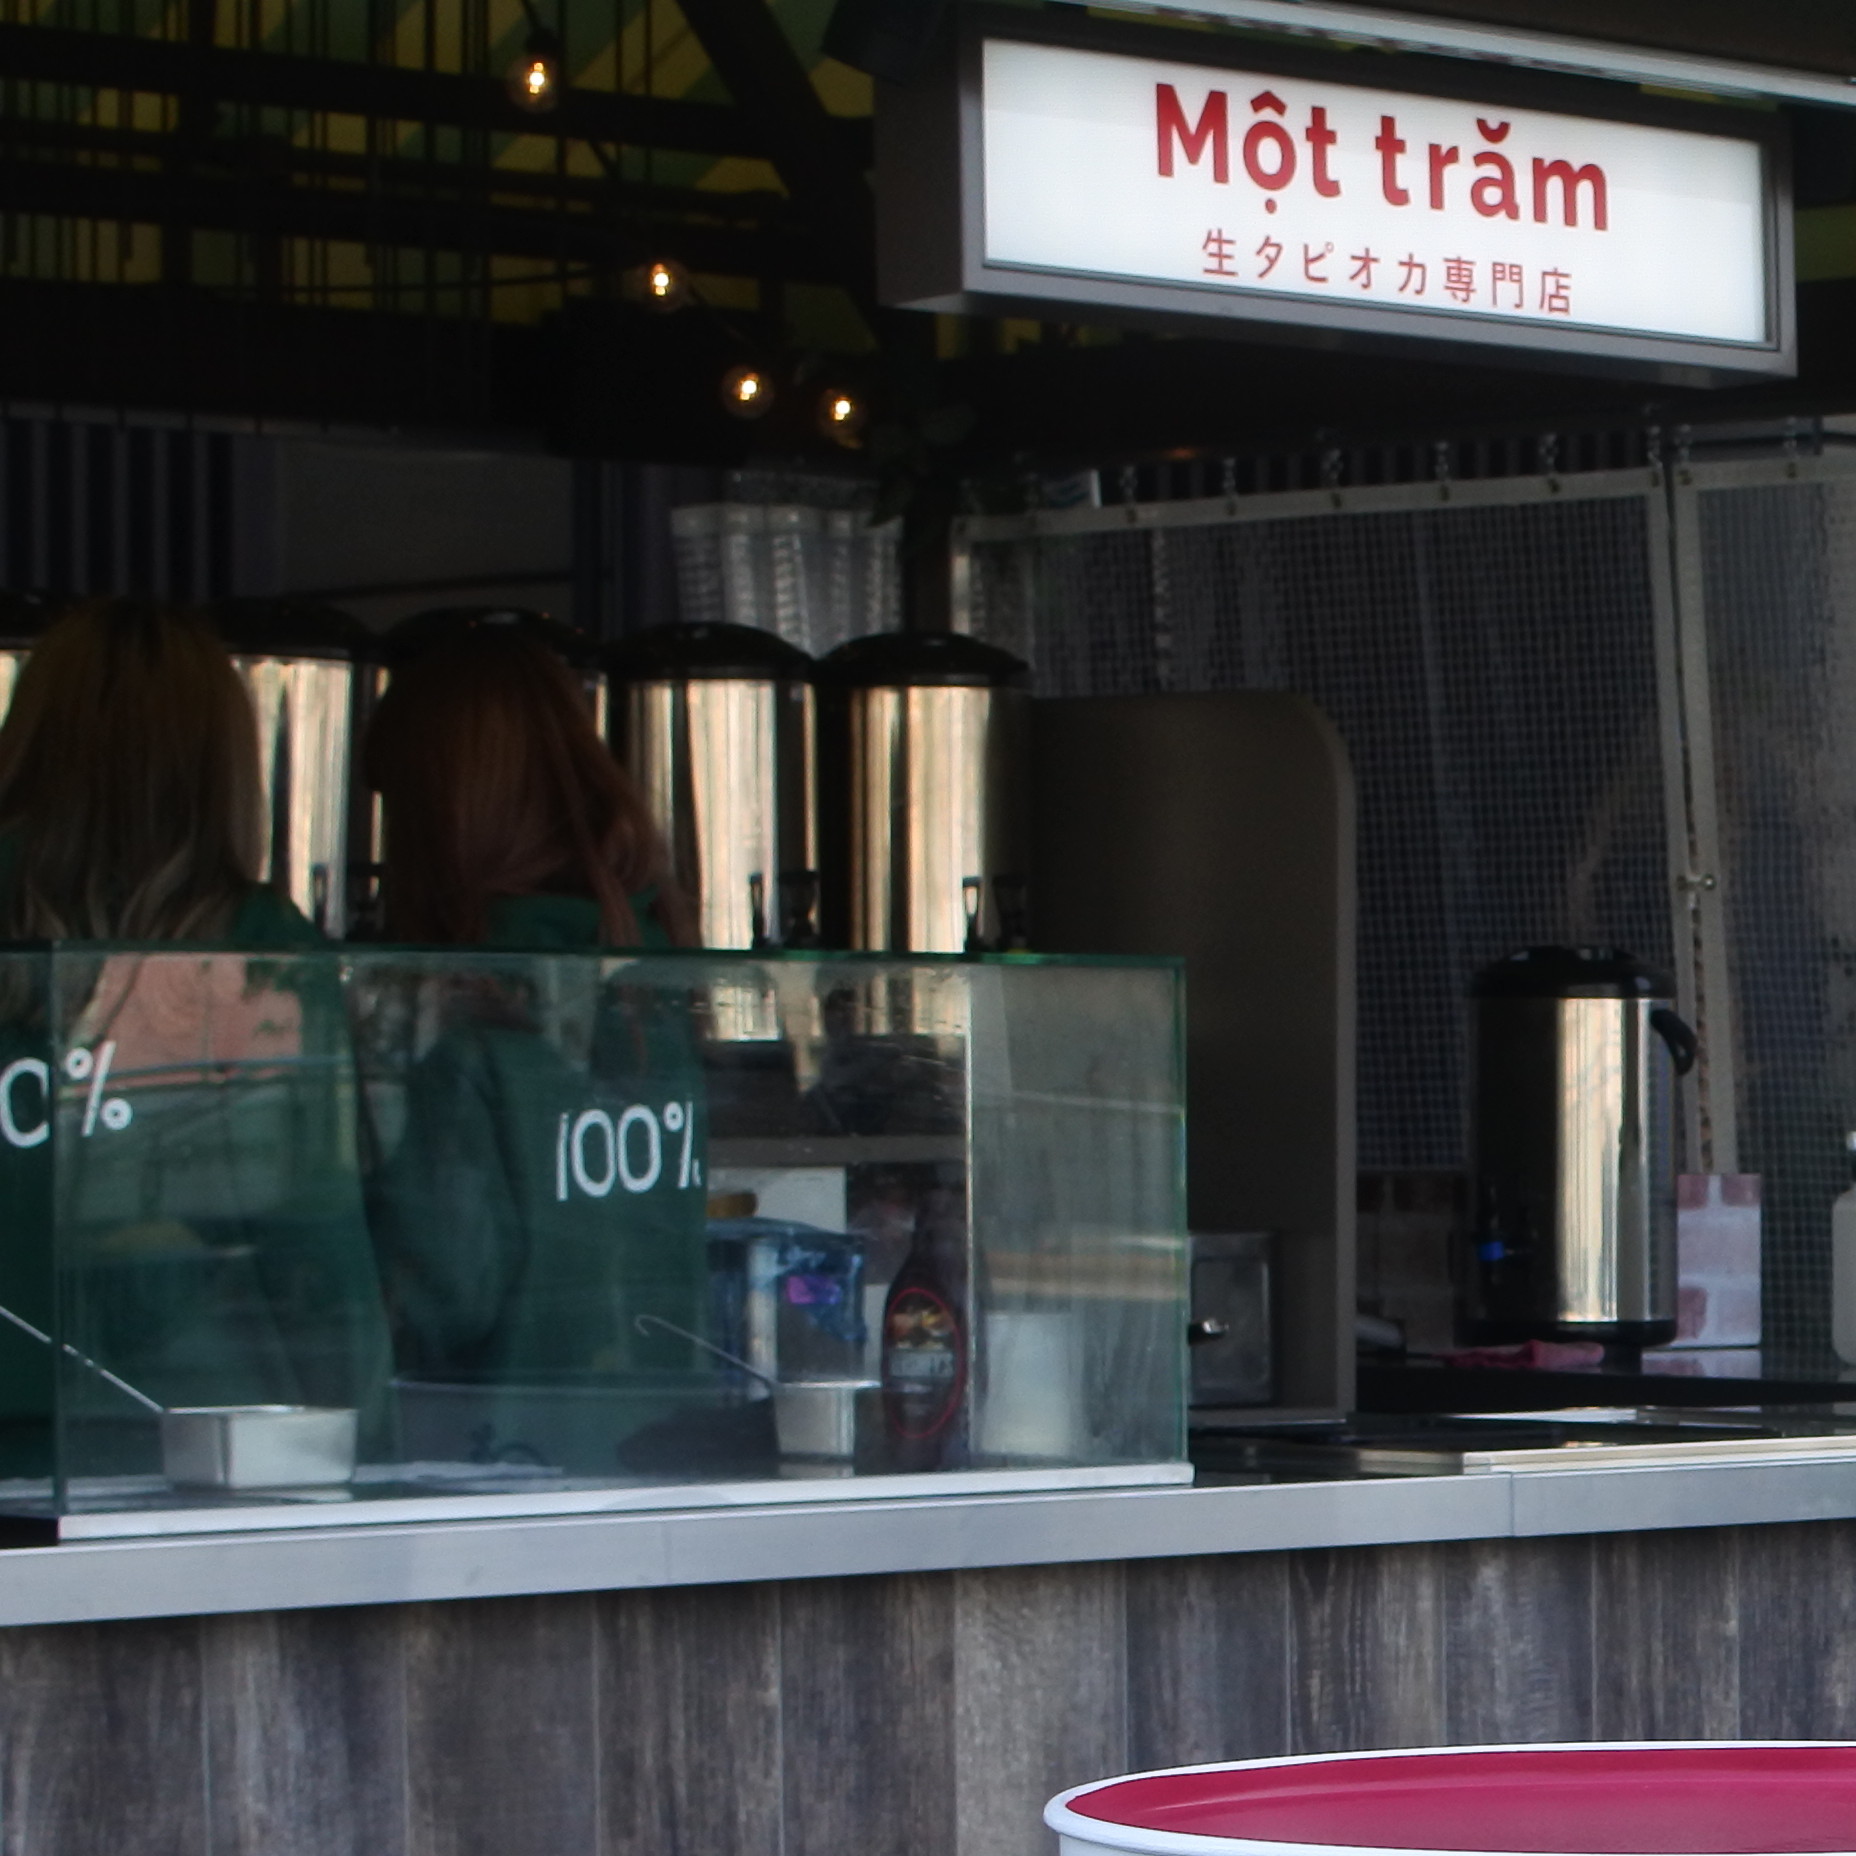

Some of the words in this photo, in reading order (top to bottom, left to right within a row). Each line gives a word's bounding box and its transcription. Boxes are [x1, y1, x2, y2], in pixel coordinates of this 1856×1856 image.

[1155, 83, 1341, 214] Một
[1375, 115, 1608, 231] trăm
[1202, 228, 1572, 315] 生タピオカ専門店
[556, 1101, 701, 1201] 100%
